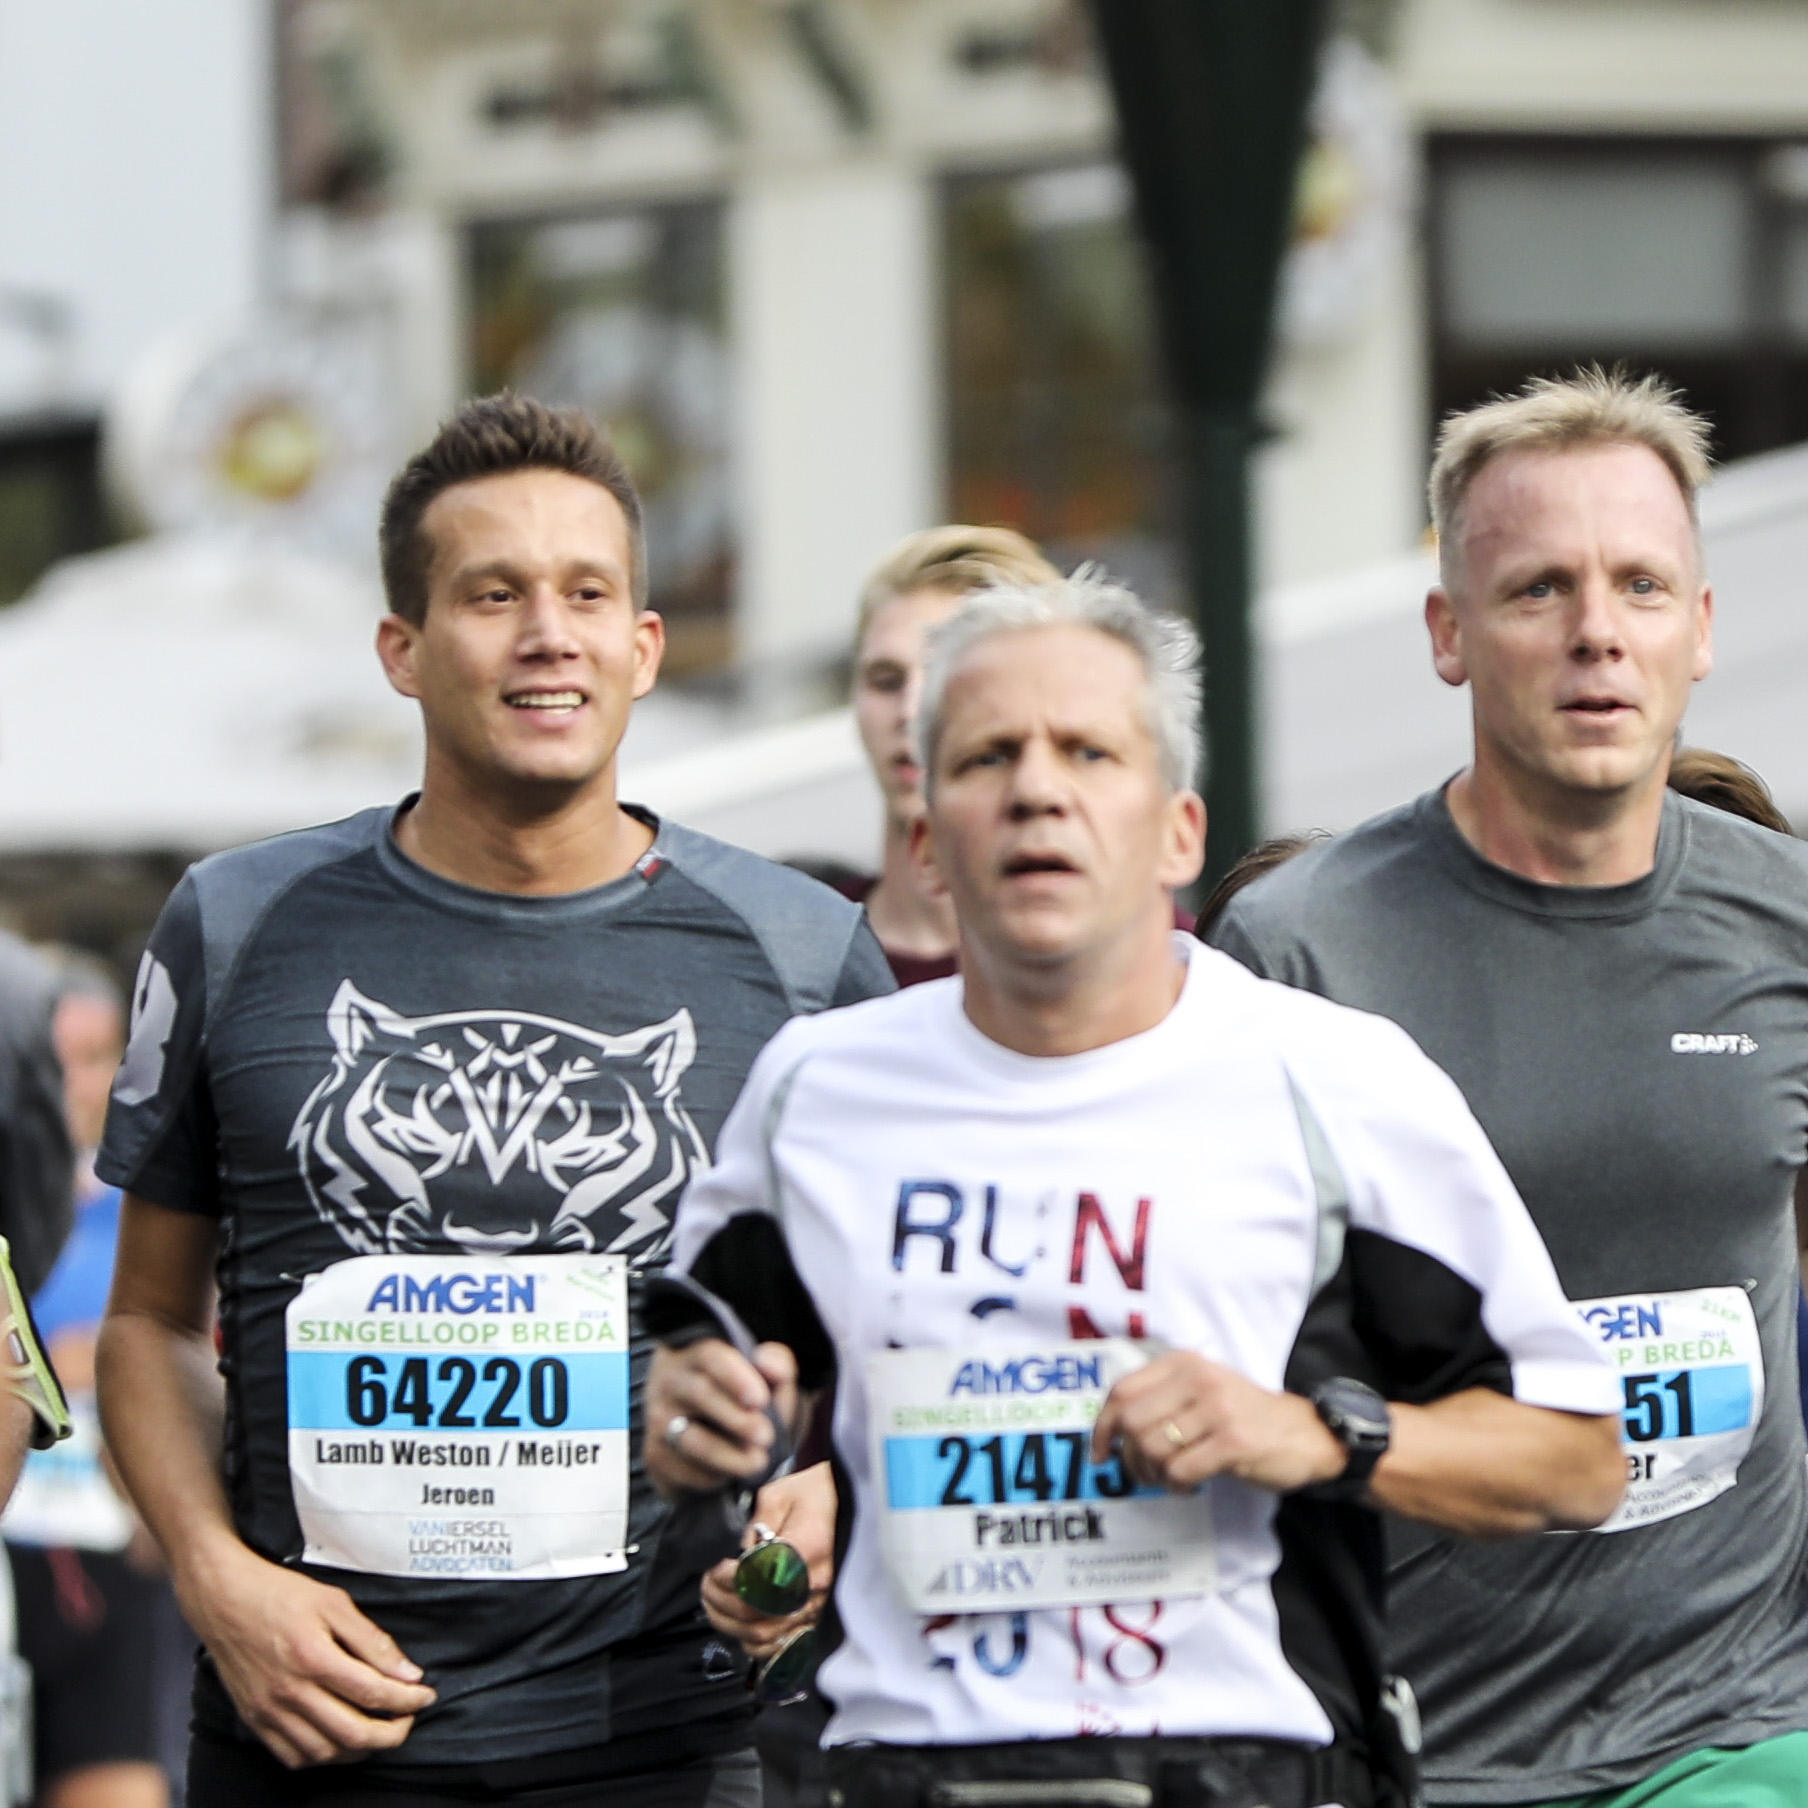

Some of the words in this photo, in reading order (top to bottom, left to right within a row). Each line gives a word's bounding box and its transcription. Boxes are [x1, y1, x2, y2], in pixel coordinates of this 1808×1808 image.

[1670, 1032, 1742, 1055] CRAFT
[890, 1177, 1153, 1293] RUN
[366, 1273, 536, 1314] AMGEN
[296, 1319, 499, 1345] SINGELLOOP
[512, 1319, 617, 1343] BREDA
[1644, 1338, 1736, 1366] BREDA
[949, 1355, 1101, 1397] AMGEN
[346, 1355, 569, 1428] 64220
[1625, 1370, 1694, 1442] 51
[315, 1438, 384, 1465] Lamb
[390, 1439, 491, 1467] Weston
[497, 1442, 508, 1467] /
[517, 1440, 602, 1468] Meijer
[1625, 1453, 1658, 1482] er
[420, 1483, 495, 1506] Jeroen
[974, 1506, 1105, 1547] Patrick
[409, 1539, 512, 1555] LUCHTMAN
